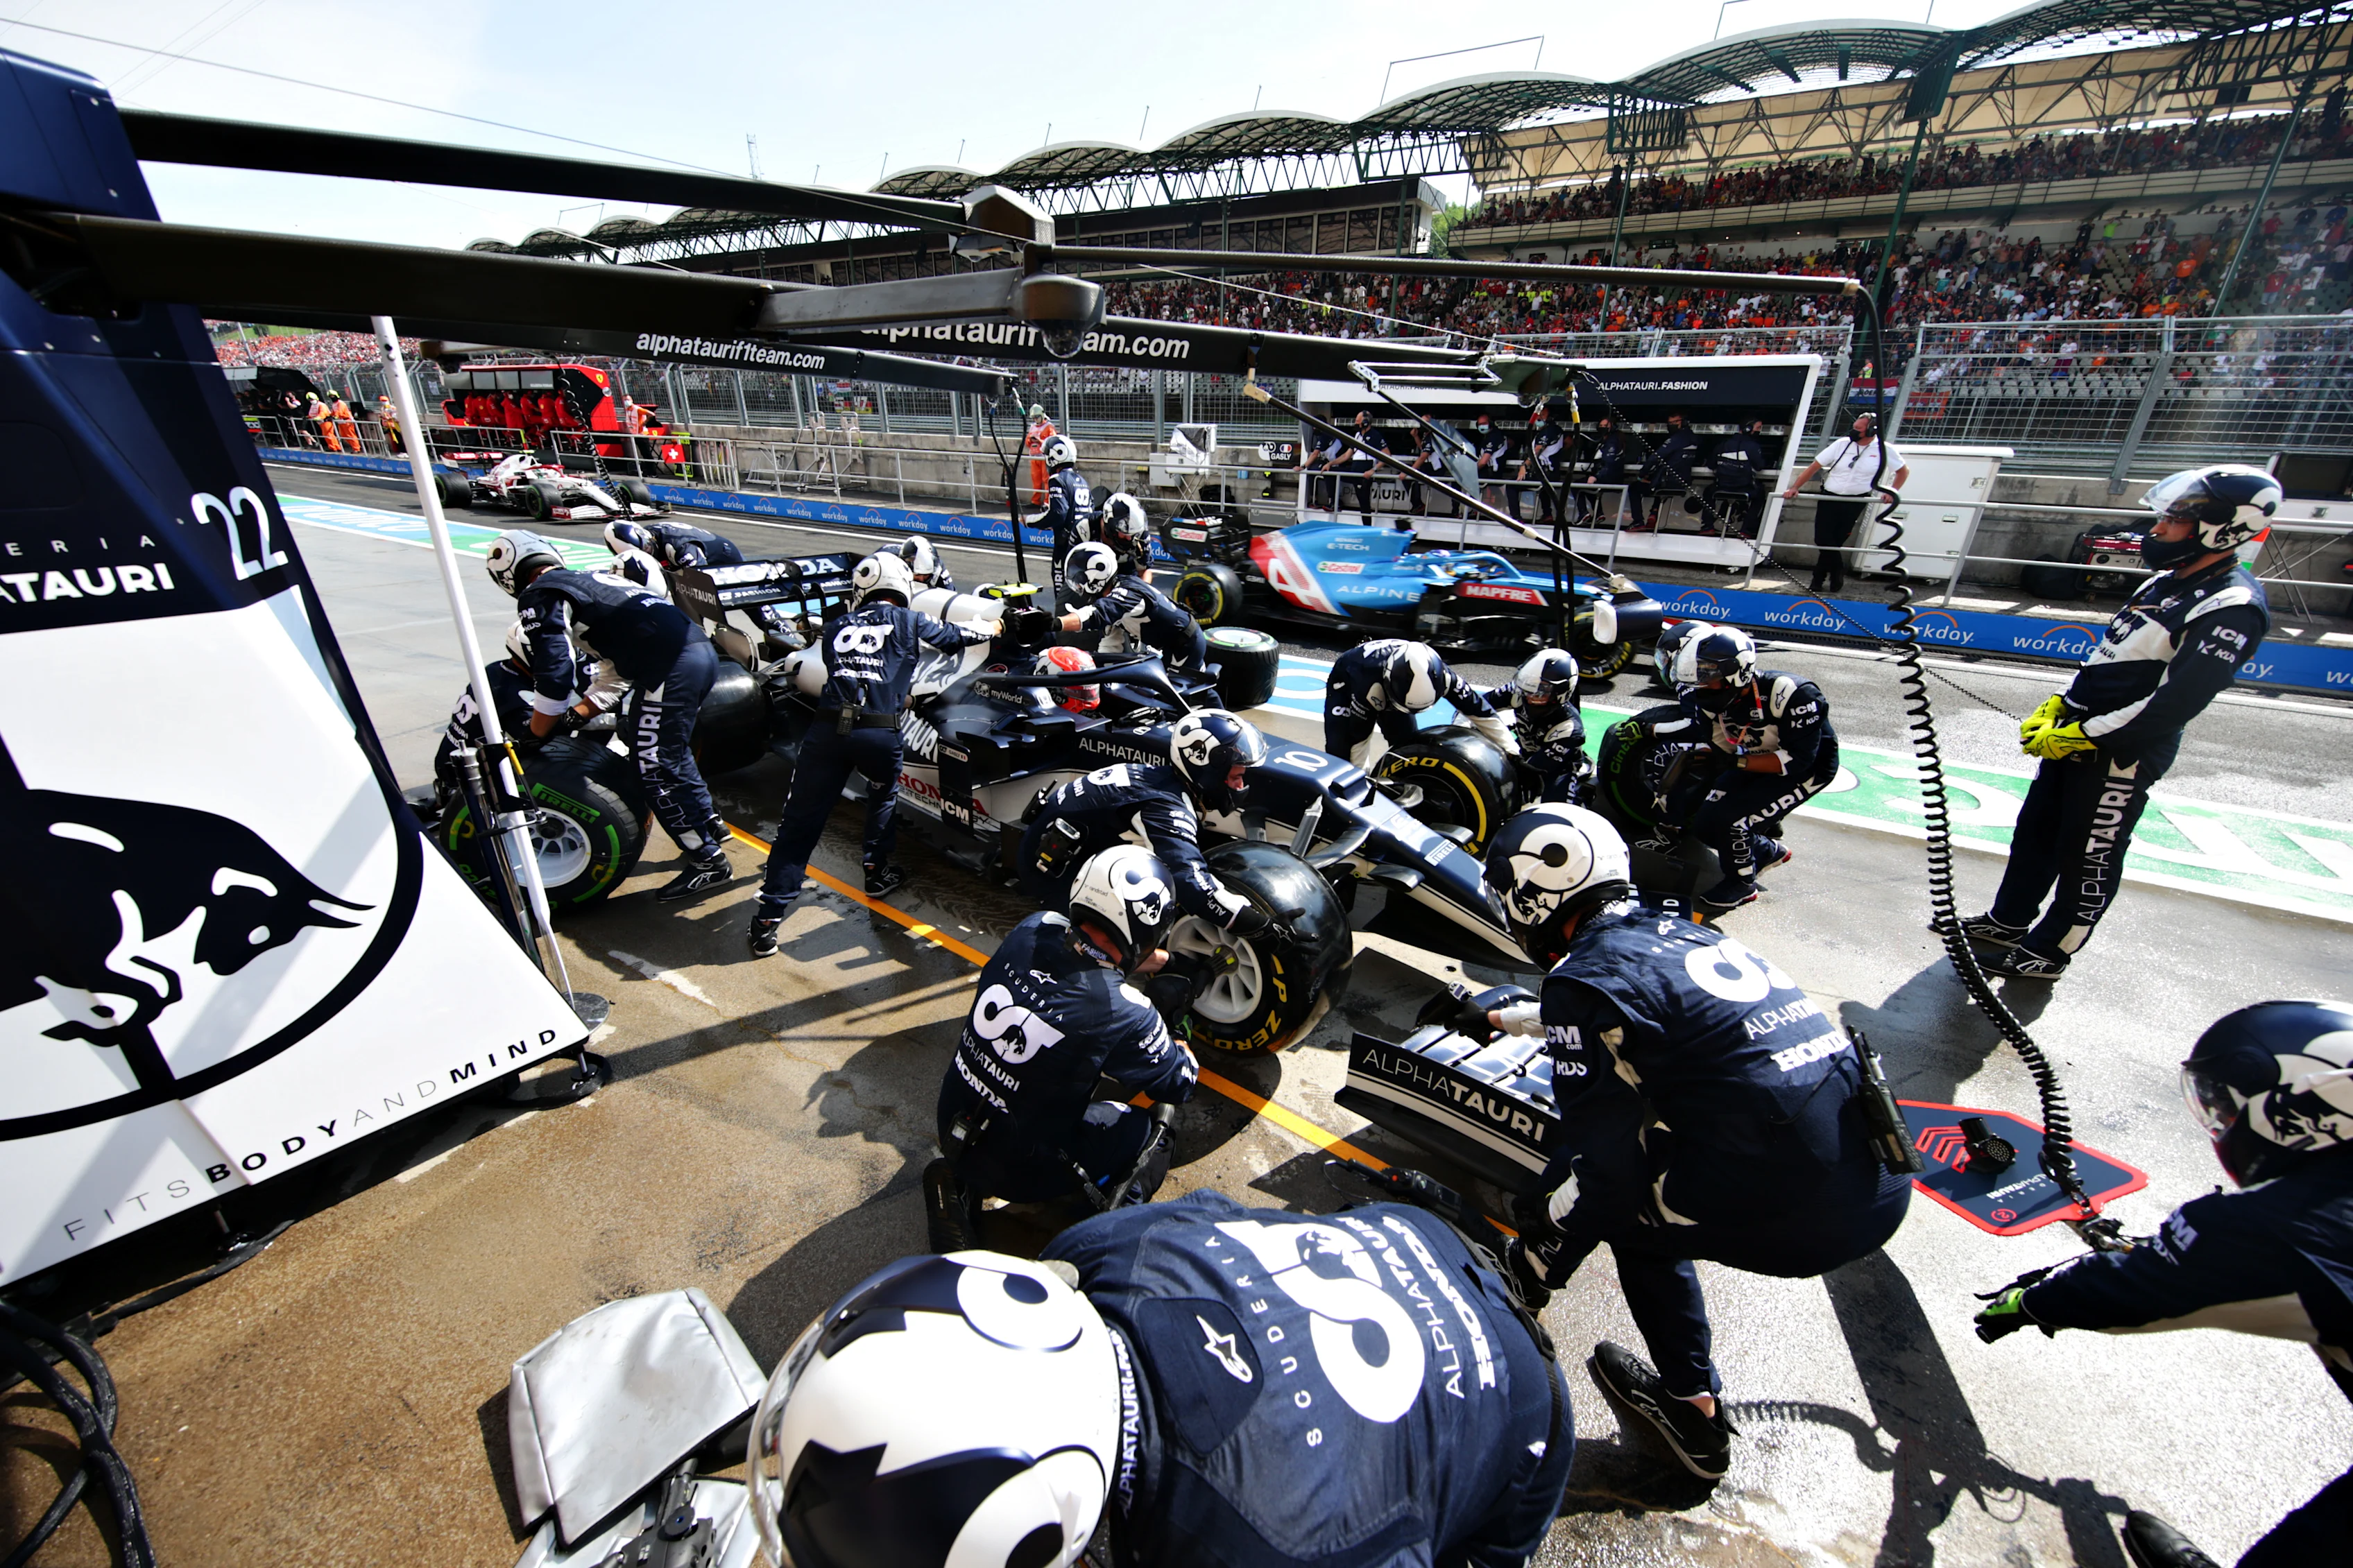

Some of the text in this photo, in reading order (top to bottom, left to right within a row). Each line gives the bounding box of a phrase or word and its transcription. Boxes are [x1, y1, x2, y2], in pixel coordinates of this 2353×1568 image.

[636, 333, 825, 369] alphataurif1team.com
[1271, 452, 1292, 461] GASLY
[723, 501, 745, 512] workday
[753, 504, 777, 515] workday
[787, 508, 812, 519] workday
[822, 511, 848, 522] workday
[859, 515, 887, 526] workday
[898, 519, 929, 531] workday
[940, 523, 970, 536] workday
[191, 486, 289, 581] 22
[1336, 585, 1421, 603] ALPINE
[1466, 585, 1532, 602] MAPFRE
[1660, 600, 1730, 620] workday
[1765, 610, 1845, 632] workday
[991, 689, 1023, 705] myWorld
[1790, 700, 1818, 716] ICM
[637, 706, 692, 828] ALPHATAURI
[1274, 751, 1328, 772] 10
[531, 782, 601, 824] PIRELLI
[941, 798, 970, 822] ICM
[2077, 779, 2135, 922] ALPHATAURI
[1004, 962, 1064, 1022] SCUDERIA
[1214, 1009, 1282, 1051] ZERO
[962, 1028, 1021, 1092] ALPHATAURI
[1557, 1061, 1588, 1076] RDS
[1362, 1049, 1546, 1143] ALPHATAURI
[1206, 1236, 1324, 1447] SCUDERIA
